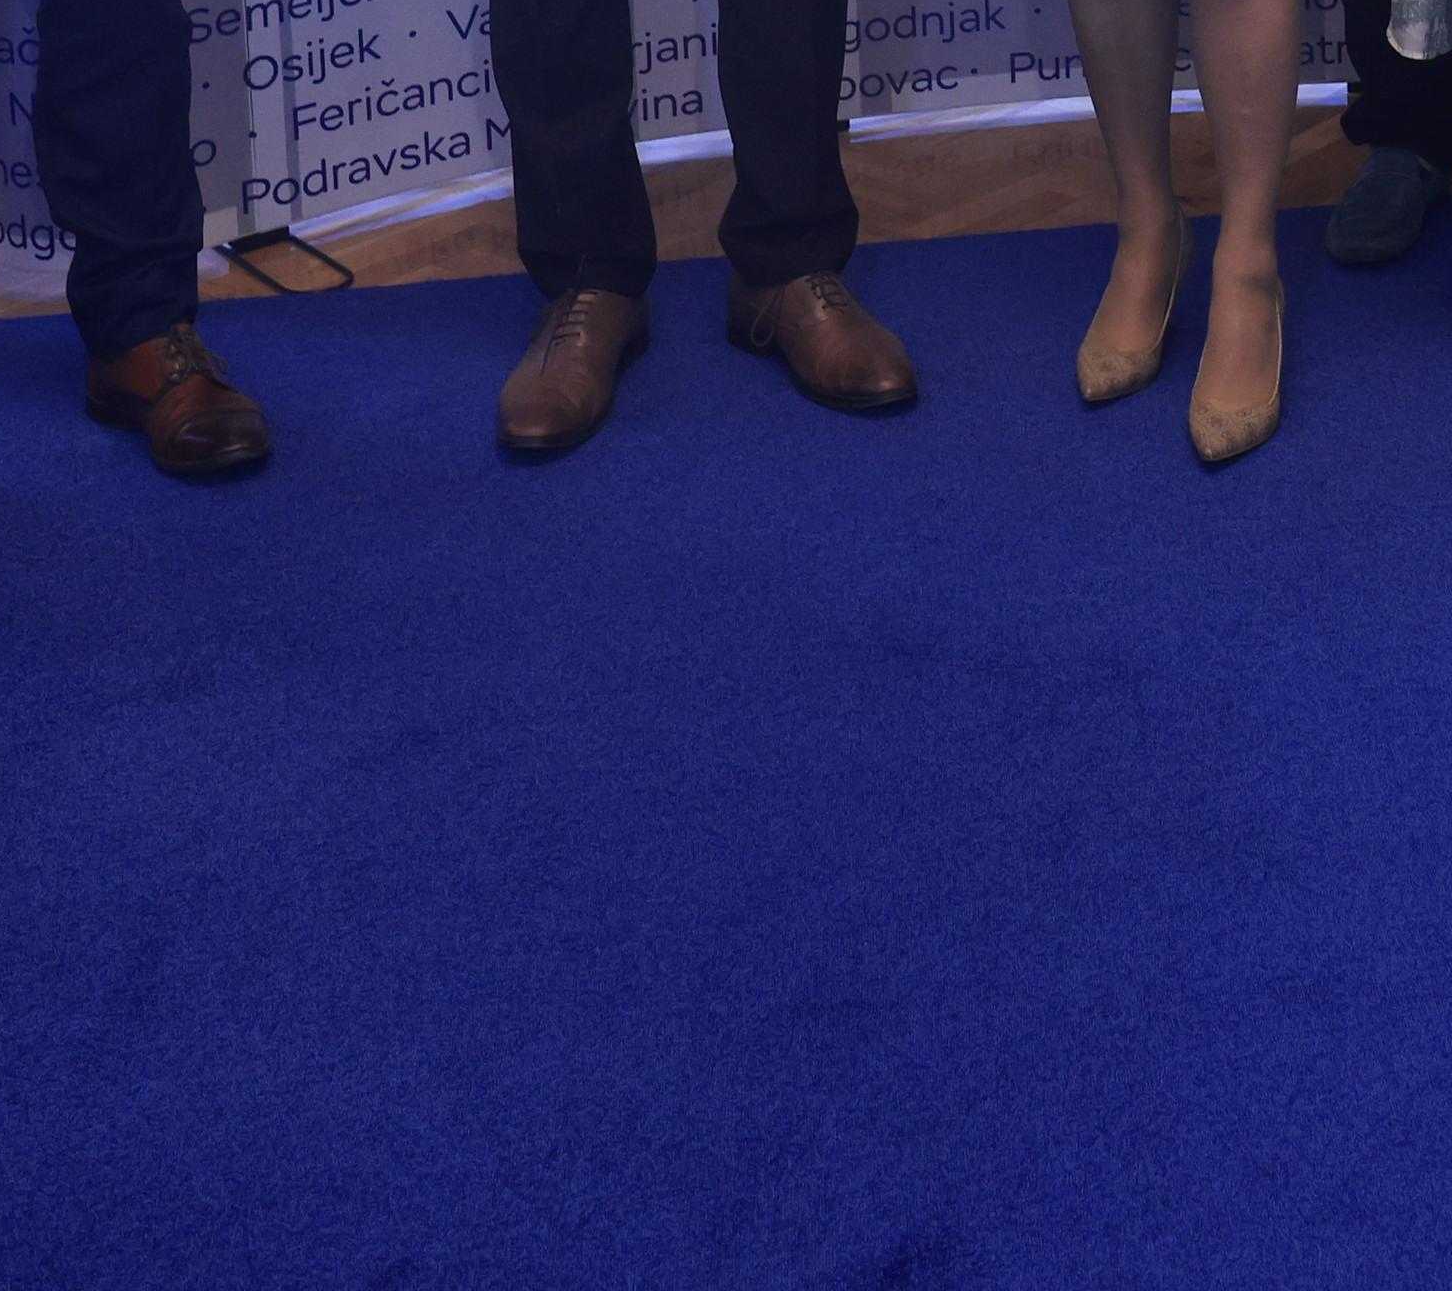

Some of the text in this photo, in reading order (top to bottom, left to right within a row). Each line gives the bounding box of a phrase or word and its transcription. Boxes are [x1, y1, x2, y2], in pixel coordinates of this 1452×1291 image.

[243, 28, 381, 90] Osijek
[292, 59, 491, 141] Feričanci
[242, 131, 471, 214] Podravska
